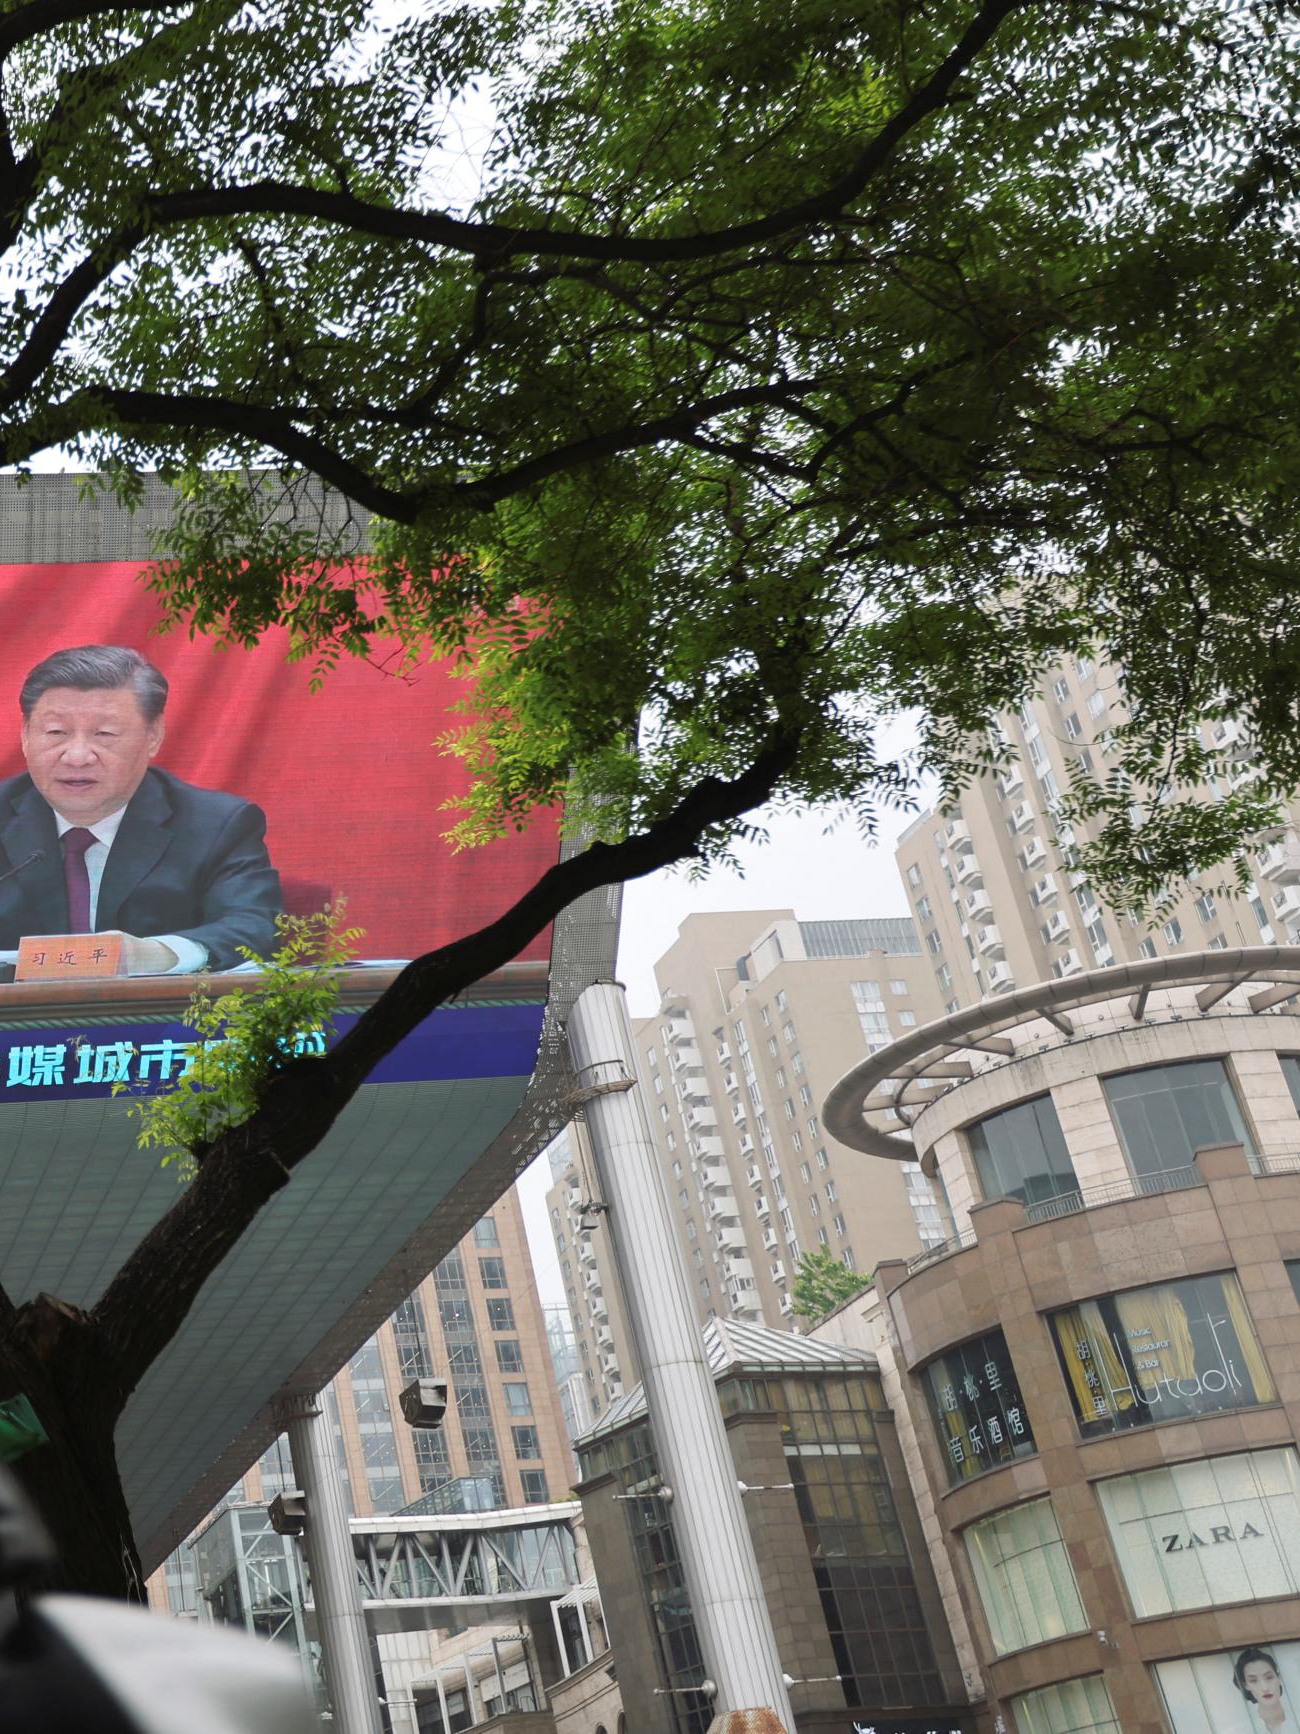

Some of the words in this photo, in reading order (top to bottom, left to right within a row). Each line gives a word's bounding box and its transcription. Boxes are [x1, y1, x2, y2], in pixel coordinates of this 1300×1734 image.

[32, 948, 107, 966] 习近平
[1094, 1312, 1242, 1412] Hutaoli
[950, 1408, 1024, 1463] 音乐酒馆
[1162, 1522, 1264, 1553] ZARA
